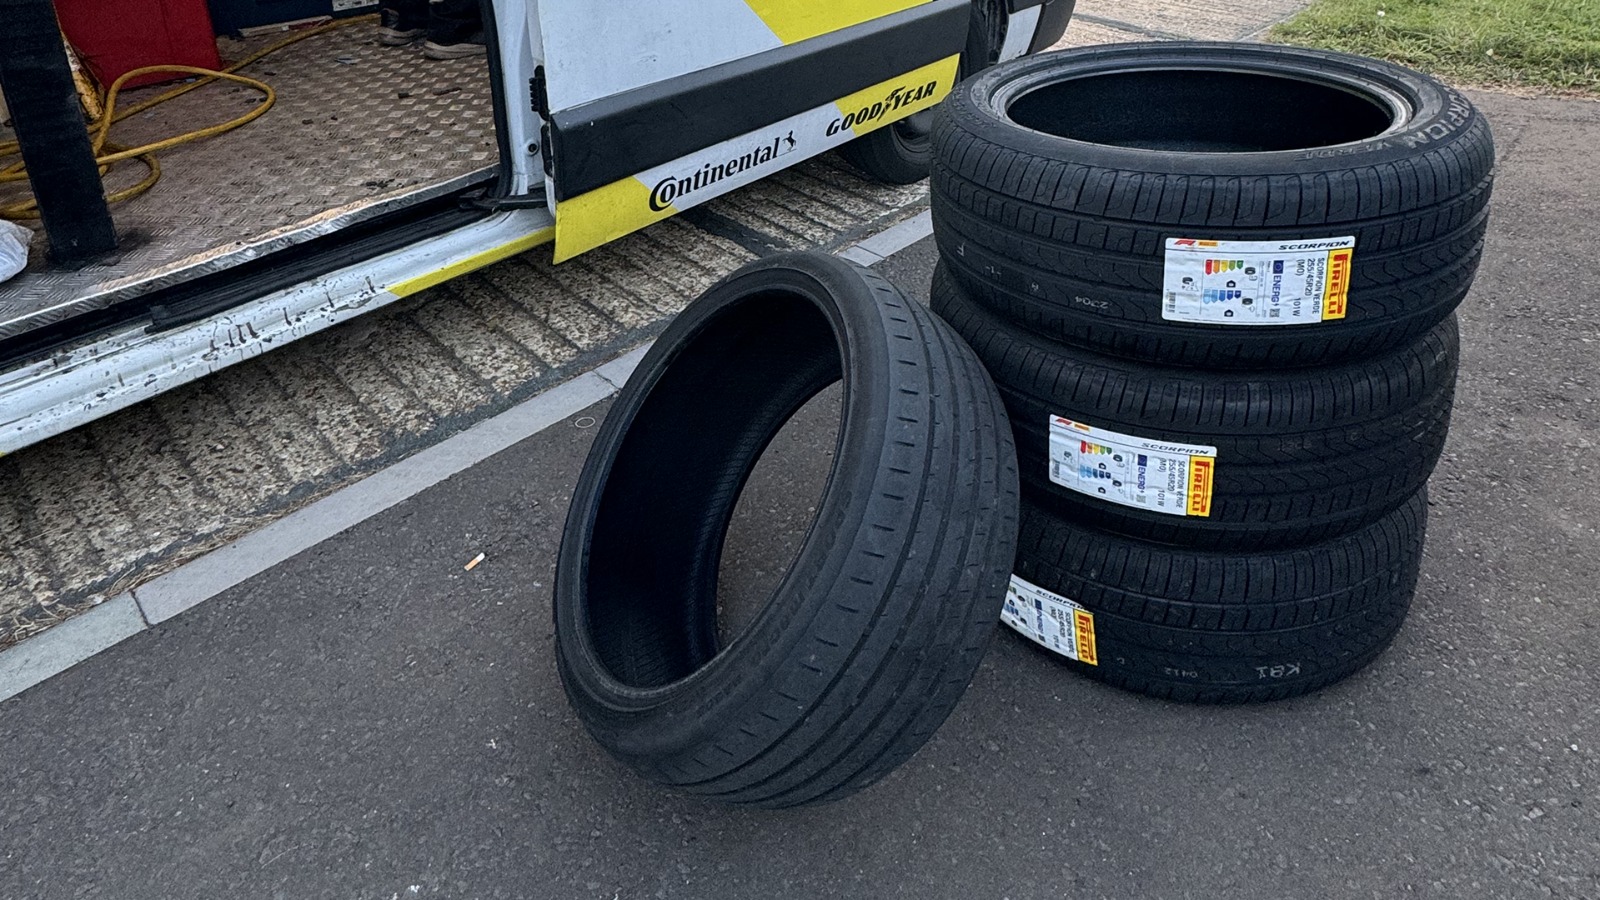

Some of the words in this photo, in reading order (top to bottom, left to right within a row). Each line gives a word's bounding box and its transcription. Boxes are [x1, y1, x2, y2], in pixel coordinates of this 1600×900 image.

[826, 81, 937, 137] GOODYEAR
[649, 137, 781, 212] Continental
[1279, 240, 1351, 250] SCORPION
[1304, 258, 1315, 297] 255/45R20
[1315, 257, 1325, 292] SCORPION
[1328, 253, 1349, 315] PIRELLI
[1312, 293, 1321, 314] VERDE
[1141, 441, 1209, 455] SCORPION
[1177, 460, 1186, 490] SCORPION
[1191, 460, 1210, 513] PIRELLI
[1078, 614, 1095, 662] PIRELLI
